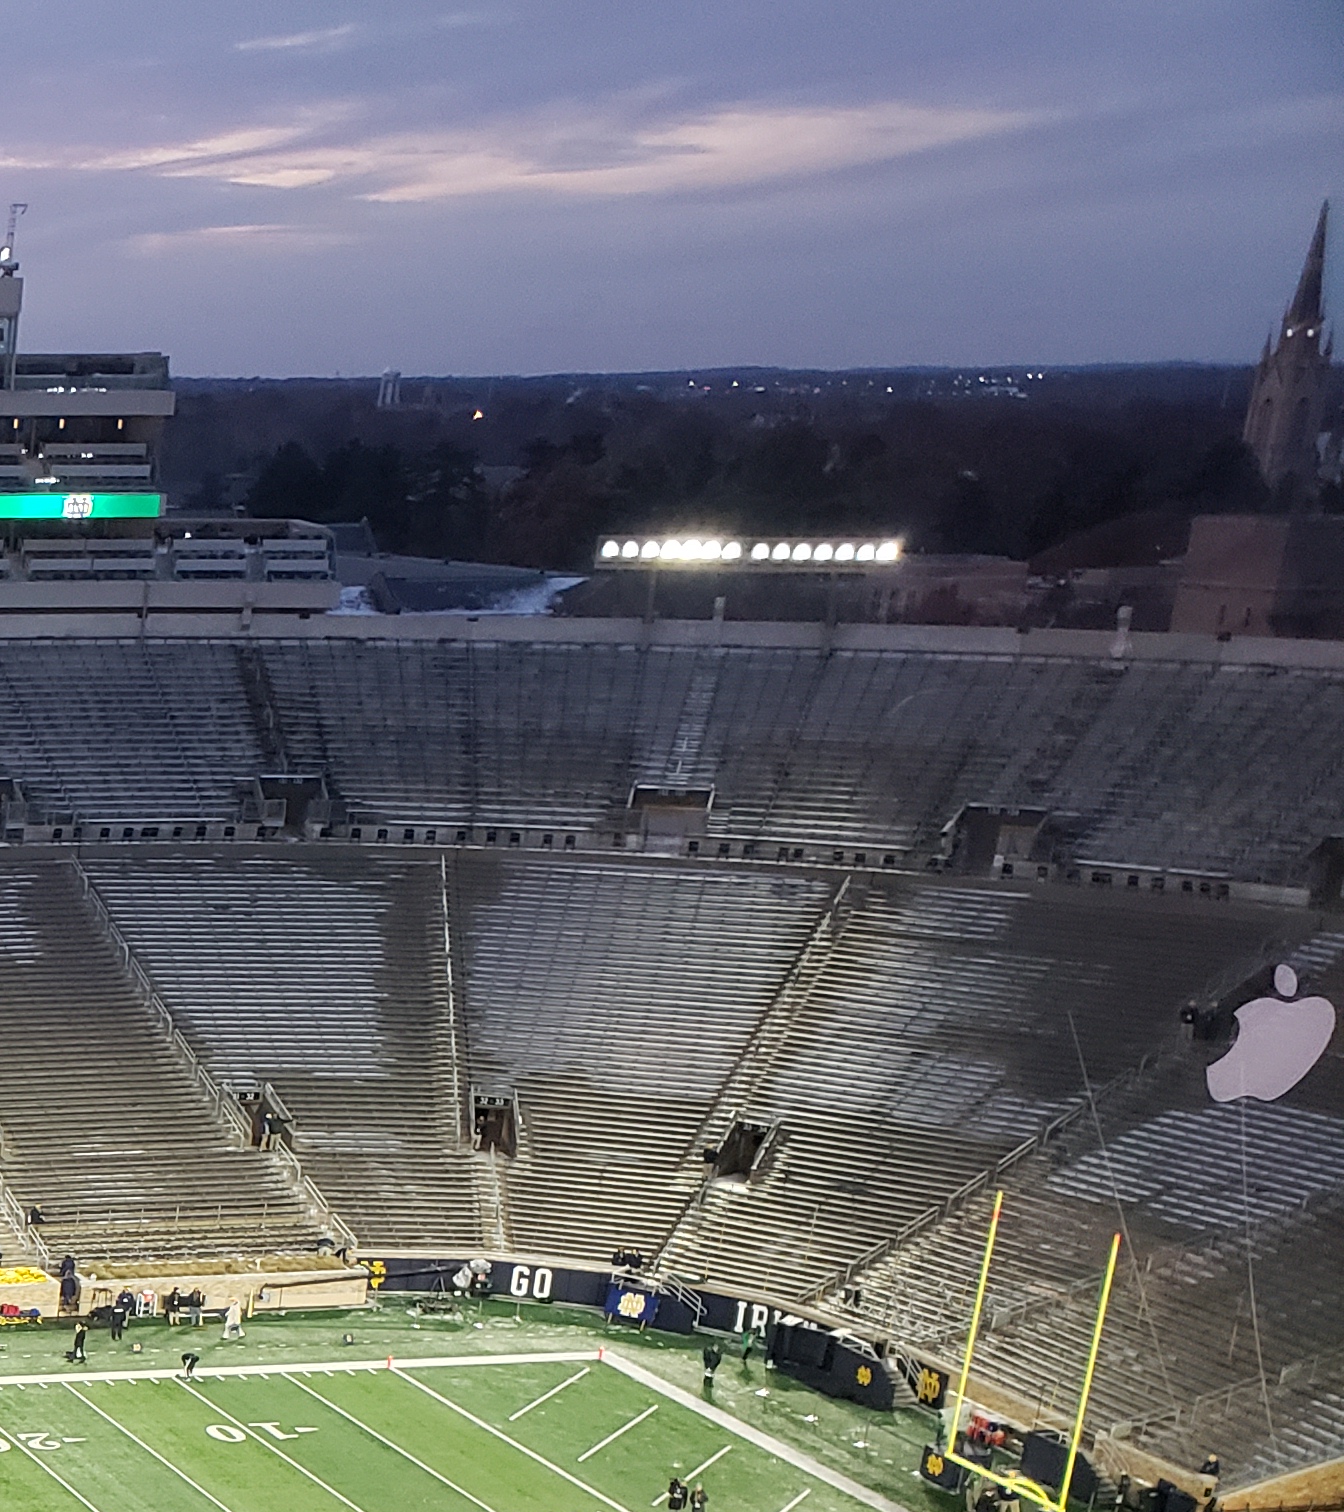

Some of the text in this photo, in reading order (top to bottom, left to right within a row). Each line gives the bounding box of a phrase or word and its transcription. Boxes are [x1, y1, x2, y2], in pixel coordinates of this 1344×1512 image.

[246, 1092, 254, 1100] 32
[480, 1097, 488, 1105] 32
[511, 1266, 553, 1299] GO
